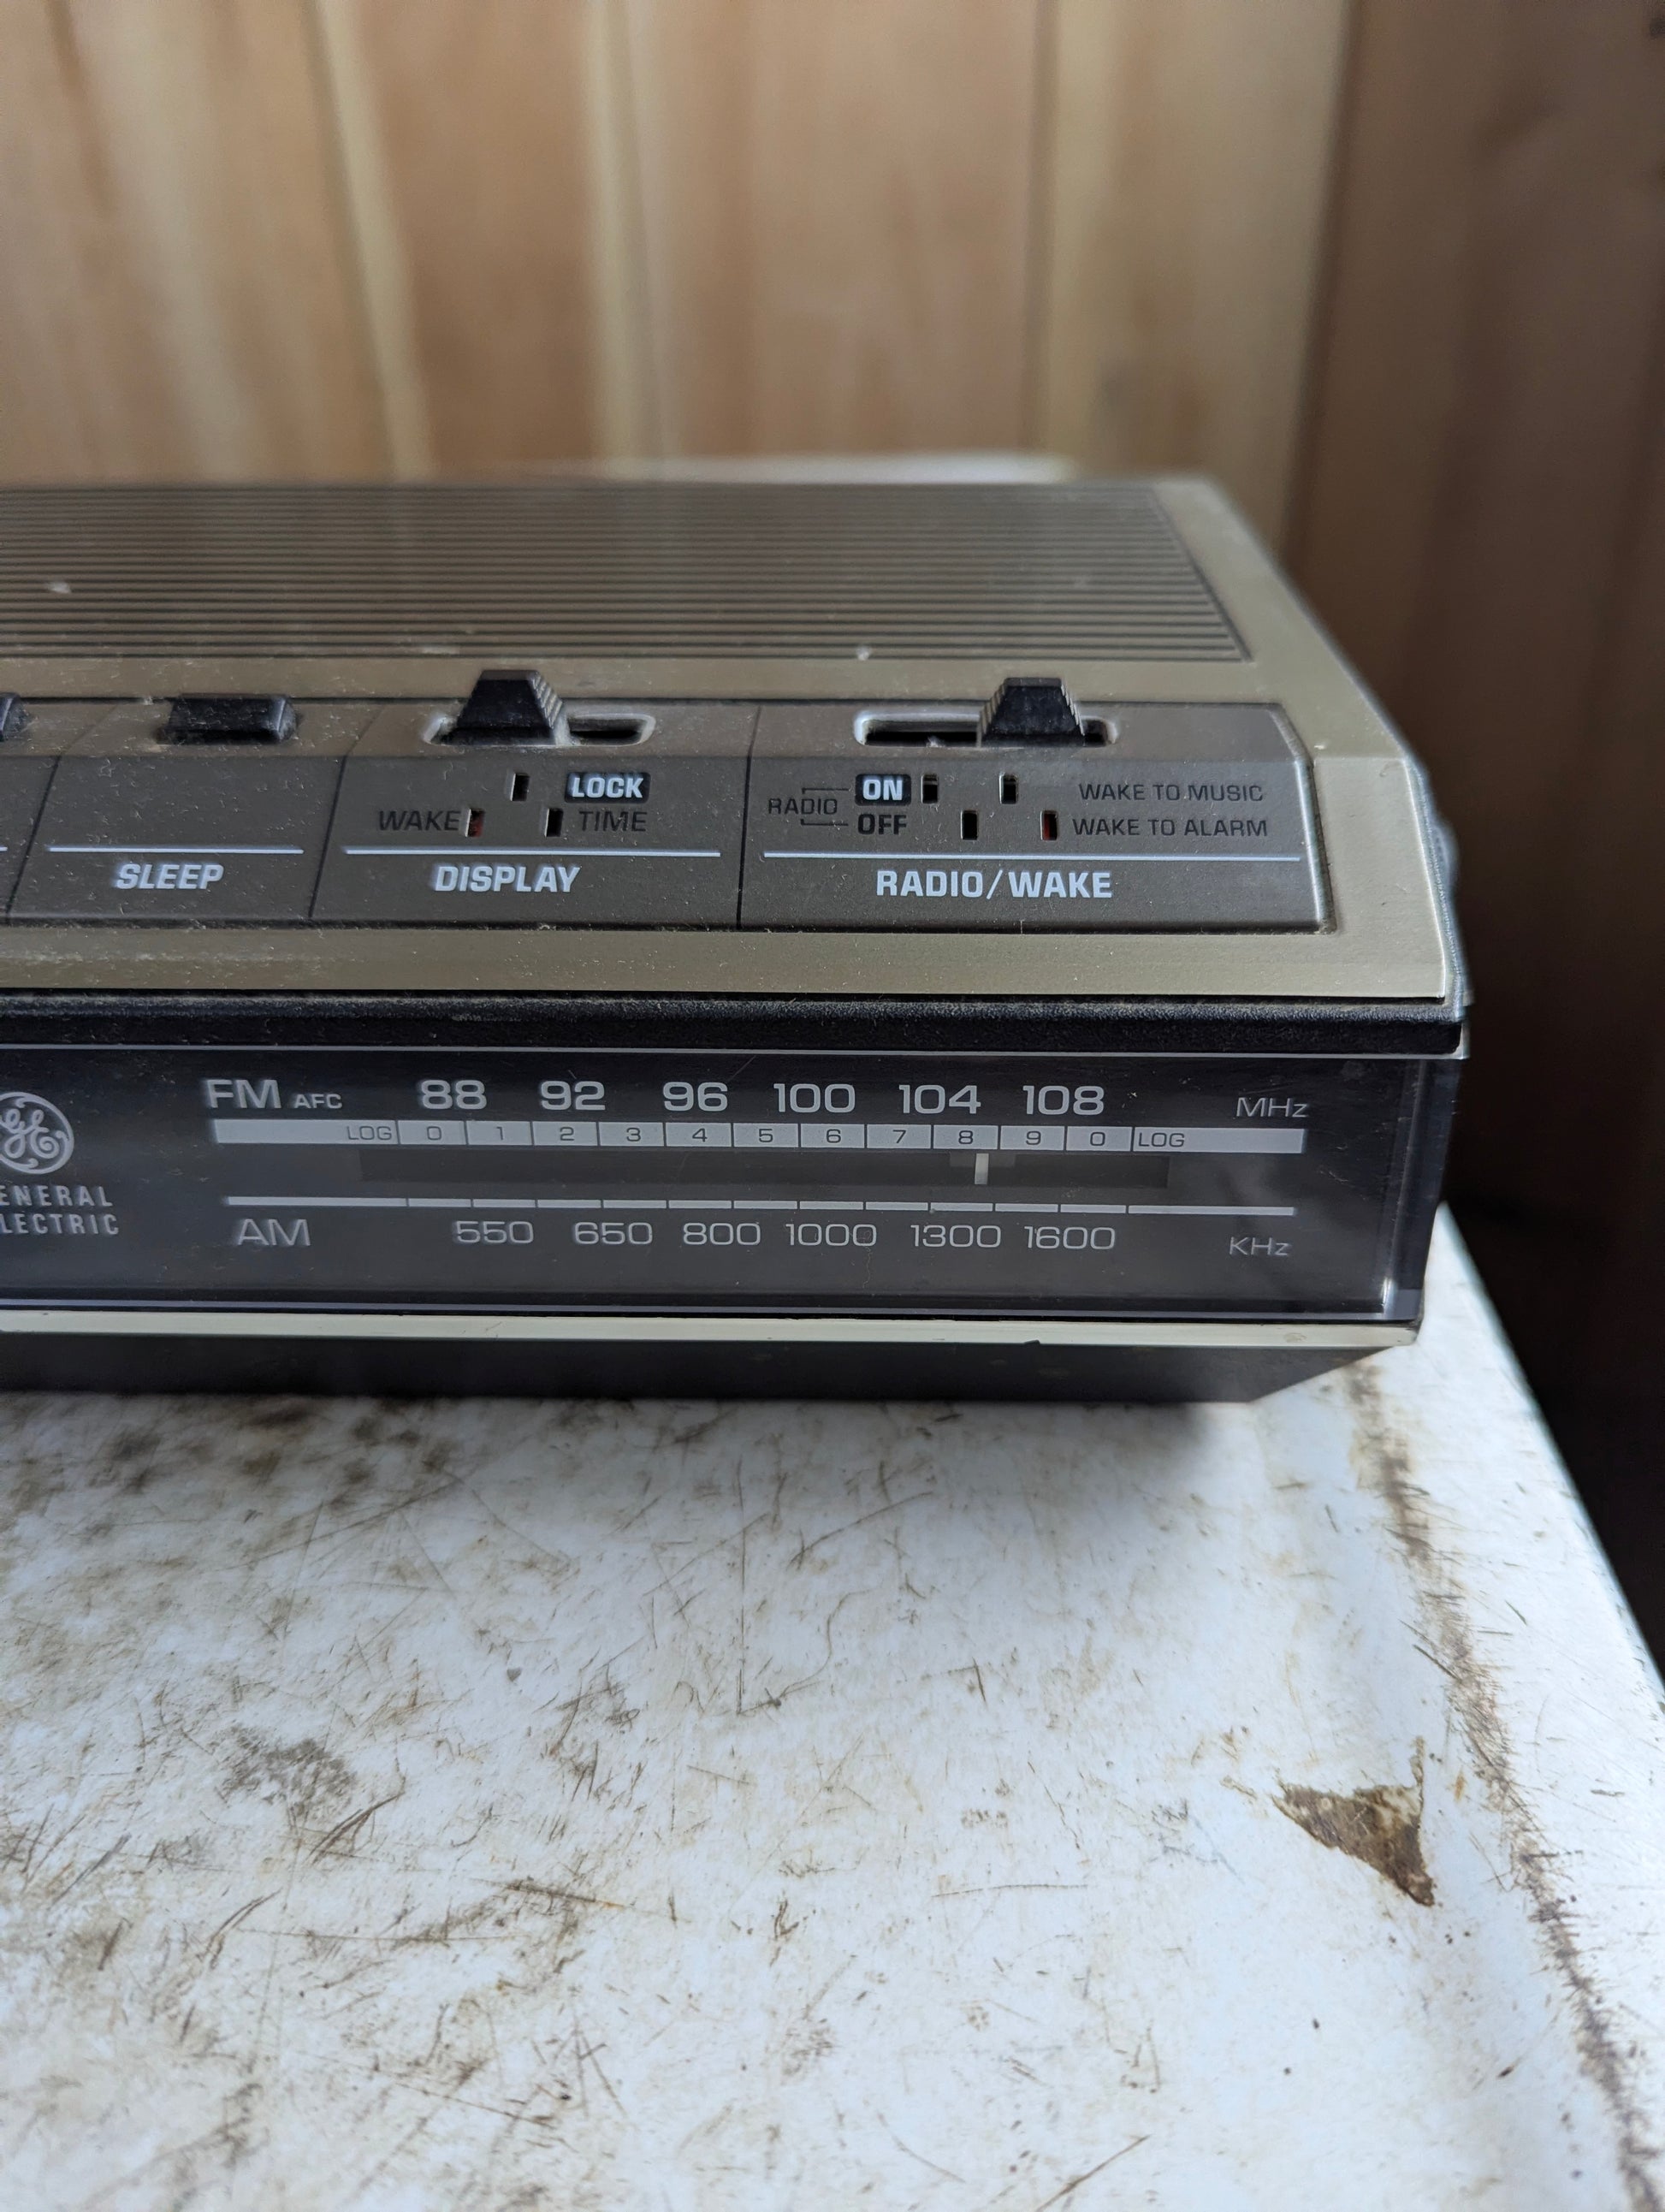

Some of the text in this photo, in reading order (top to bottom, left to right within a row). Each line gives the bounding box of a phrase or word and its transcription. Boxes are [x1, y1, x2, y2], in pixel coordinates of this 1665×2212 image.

[570, 776, 644, 799] LOCK
[862, 778, 904, 801] ON
[1078, 783, 1264, 803] WAKE TO MUSIC
[768, 798, 838, 815] RADIO
[377, 809, 460, 832] WAKE
[578, 810, 648, 833] TIME
[857, 813, 908, 835] OFF
[1072, 818, 1268, 838] WAKE TO ALARM
[113, 863, 224, 890] SLEEP
[433, 864, 580, 893] DISPLAY
[875, 869, 1113, 899] RADIO/WAKE
[205, 1078, 1309, 1118] FM AFC 88 92 96 100 104 108 MHz
[347, 1125, 393, 1142] LOG
[427, 1125, 442, 1142] 0
[559, 1126, 575, 1142] 2
[625, 1127, 642, 1143] 3
[691, 1127, 708, 1143] 4
[758, 1128, 773, 1144] 5
[826, 1129, 842, 1144] 6
[892, 1129, 908, 1145] 7
[957, 1130, 975, 1146] 8
[1025, 1130, 1042, 1147] 9
[1089, 1131, 1106, 1148] 0
[1138, 1132, 1186, 1148] LOG
[0, 1185, 113, 1207] ENERAL
[0, 1213, 119, 1235] LECTRIC
[236, 1218, 1291, 1257] AM 550 650 800 1000 1300 1600 KHz
